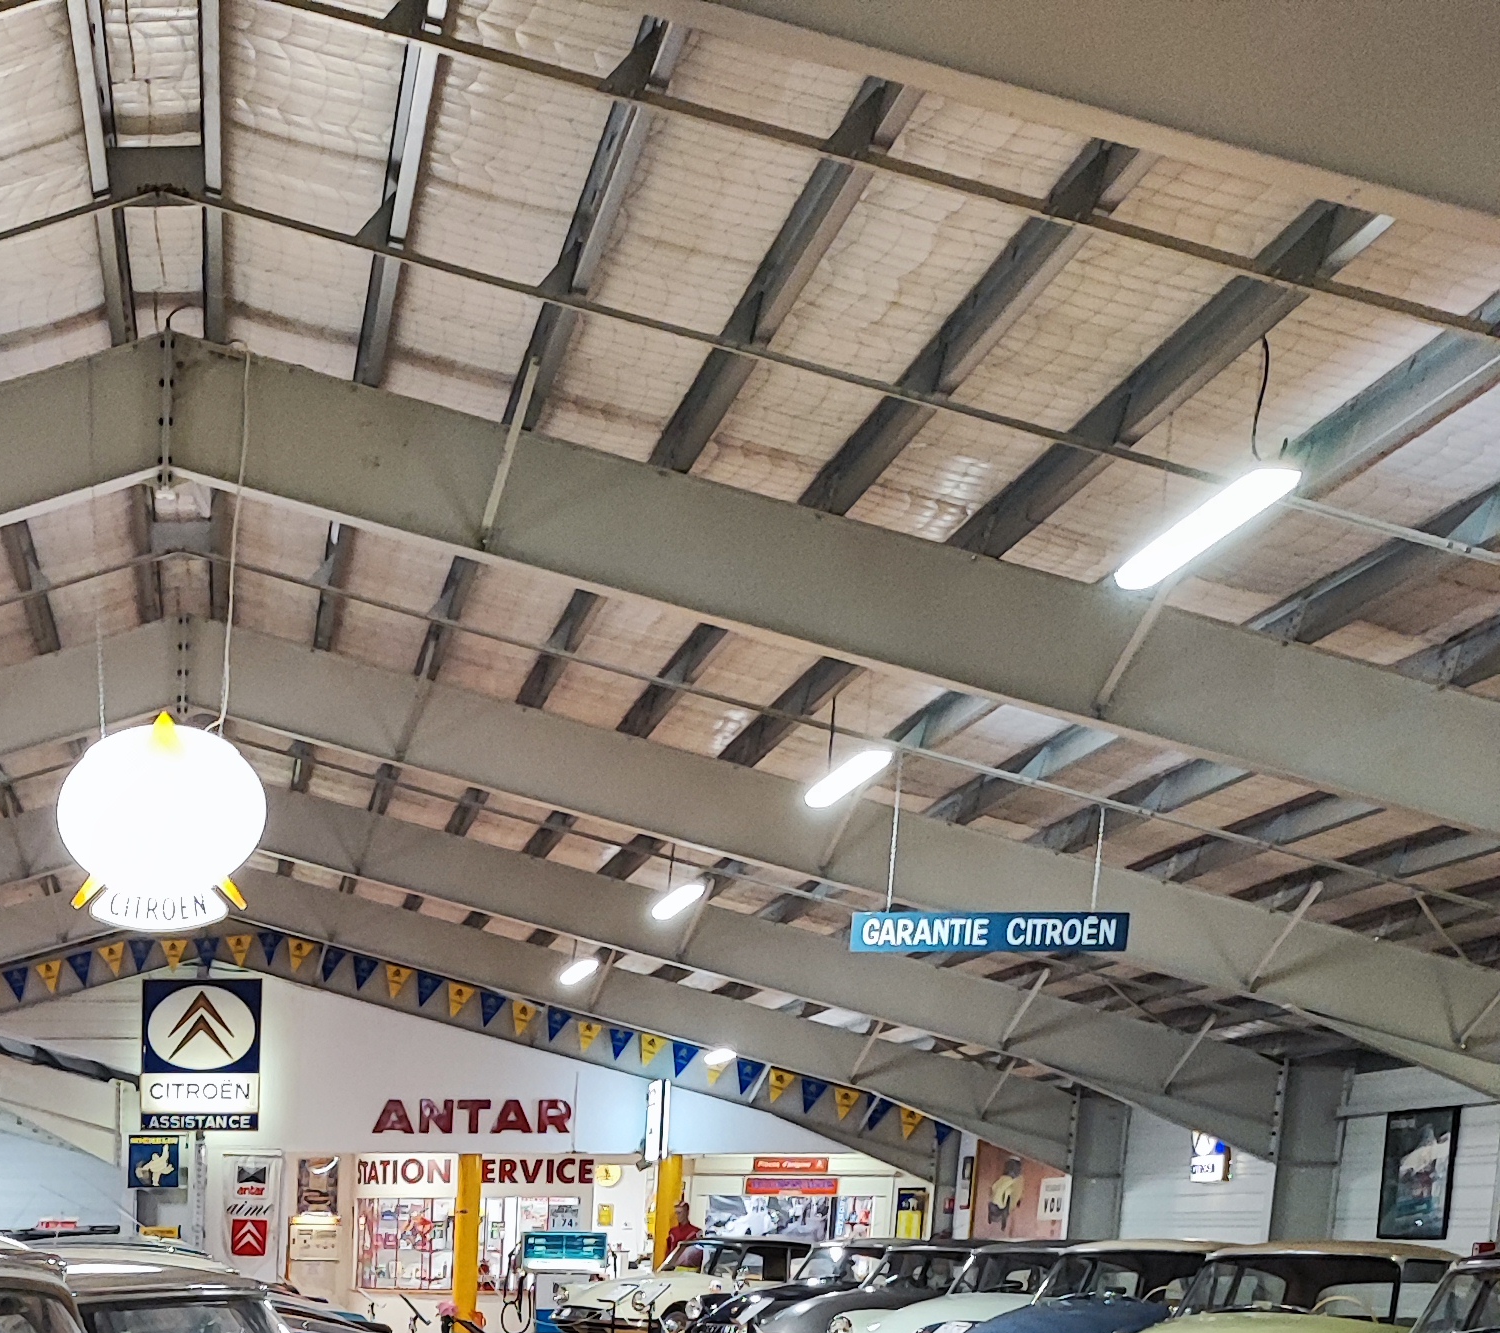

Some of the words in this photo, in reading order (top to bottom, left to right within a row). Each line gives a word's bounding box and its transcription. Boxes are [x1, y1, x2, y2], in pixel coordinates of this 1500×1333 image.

[861, 917, 990, 947] GARANTIE
[149, 1079, 251, 1100] CITROËN
[148, 1115, 252, 1130] ASSISTANCE
[371, 1098, 573, 1134] ANTAR
[481, 1157, 595, 1185] ERVICE
